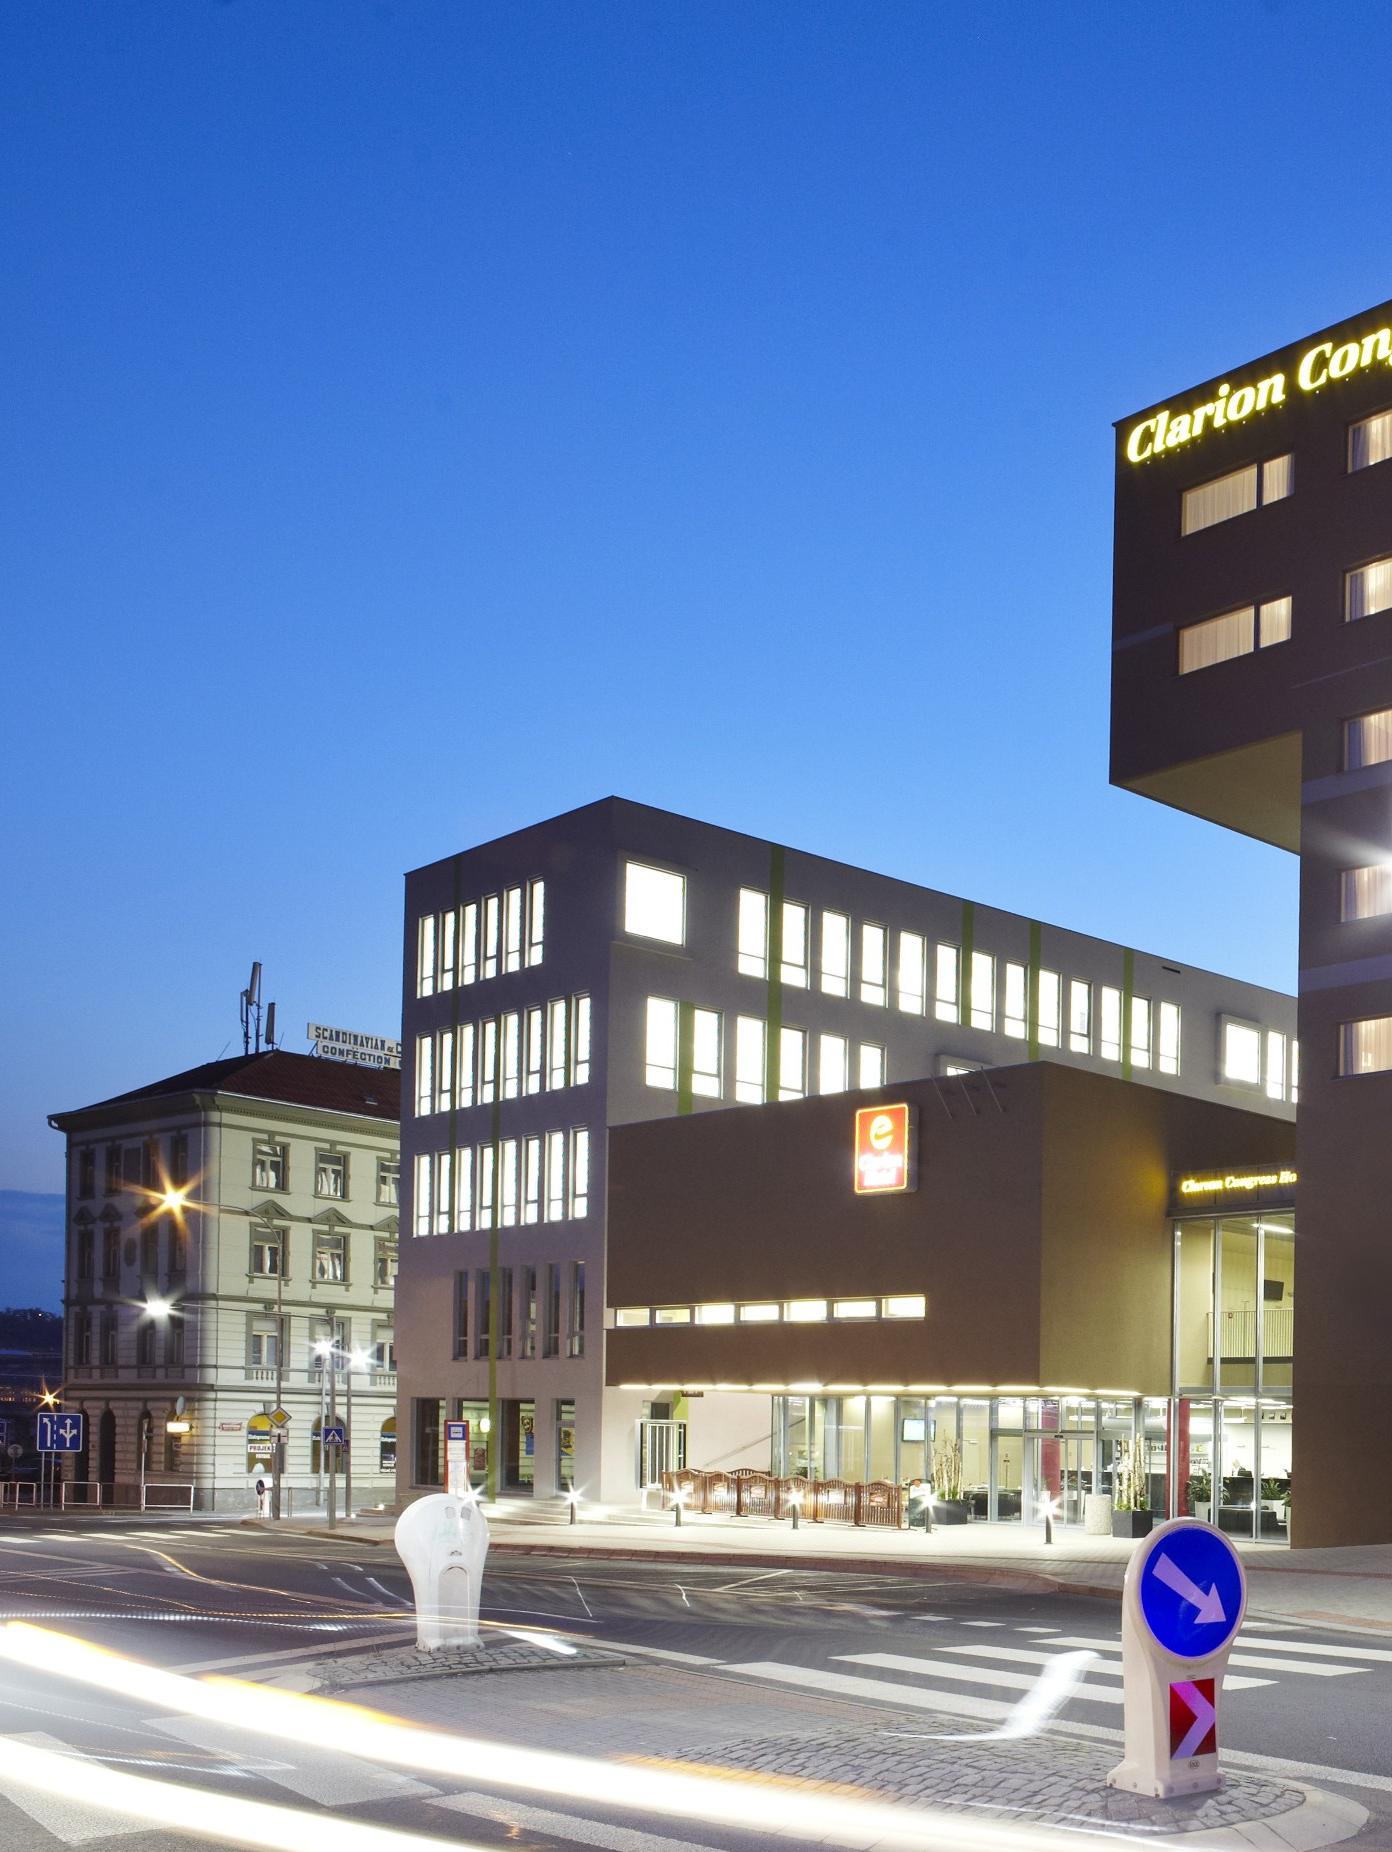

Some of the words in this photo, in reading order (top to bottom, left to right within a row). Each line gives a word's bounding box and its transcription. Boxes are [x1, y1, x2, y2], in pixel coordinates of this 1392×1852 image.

[1126, 373, 1287, 464] Clarion
[315, 1026, 386, 1052] SCANDINAVIAN
[322, 1044, 391, 1066] CONFECTION
